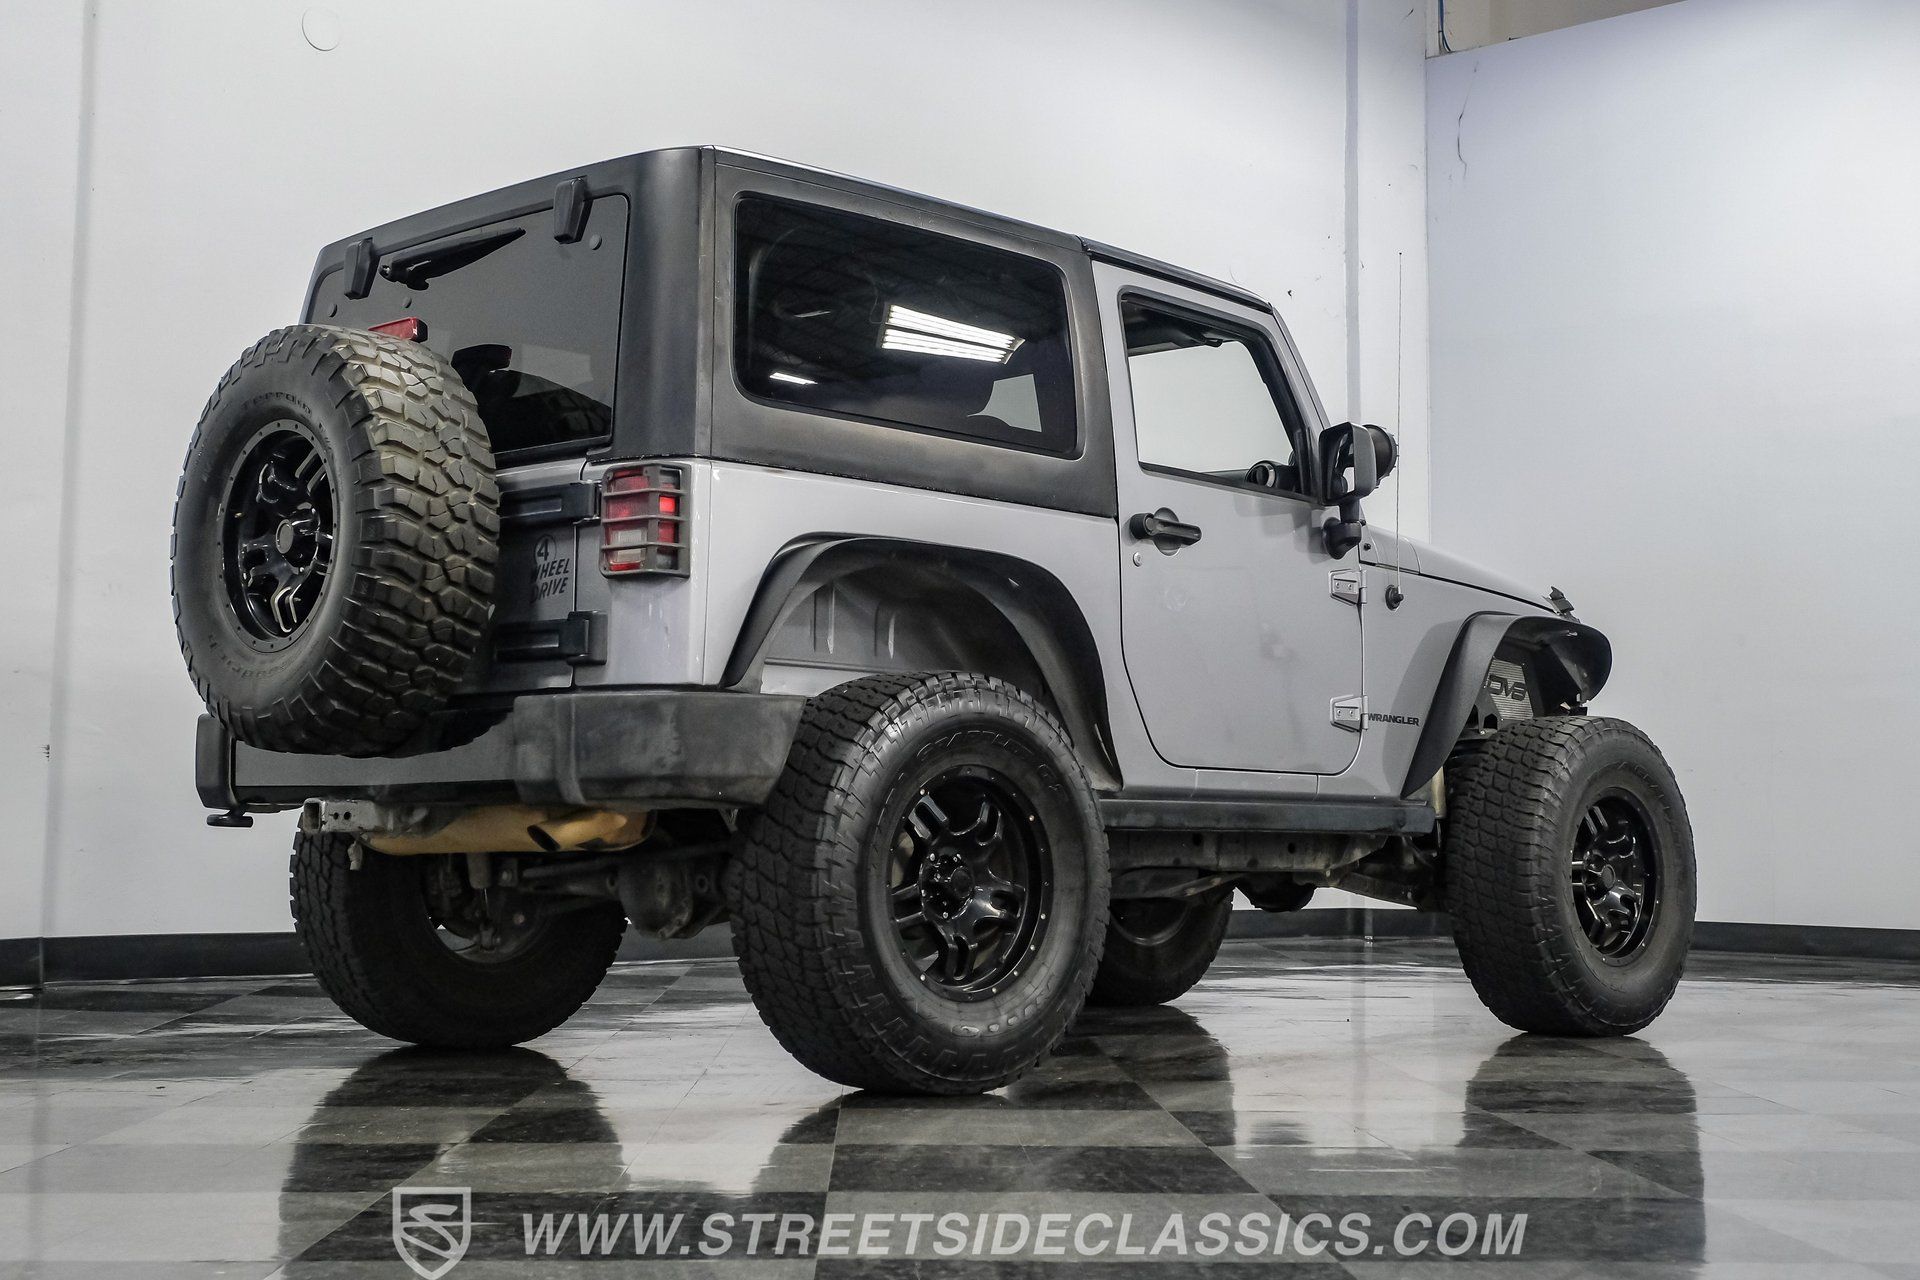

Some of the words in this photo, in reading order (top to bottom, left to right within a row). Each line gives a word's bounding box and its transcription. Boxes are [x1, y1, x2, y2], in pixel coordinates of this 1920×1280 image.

[537, 538, 549, 561] 4
[530, 577, 569, 604] DRIVE
[1366, 712, 1420, 727] WRANGLER
